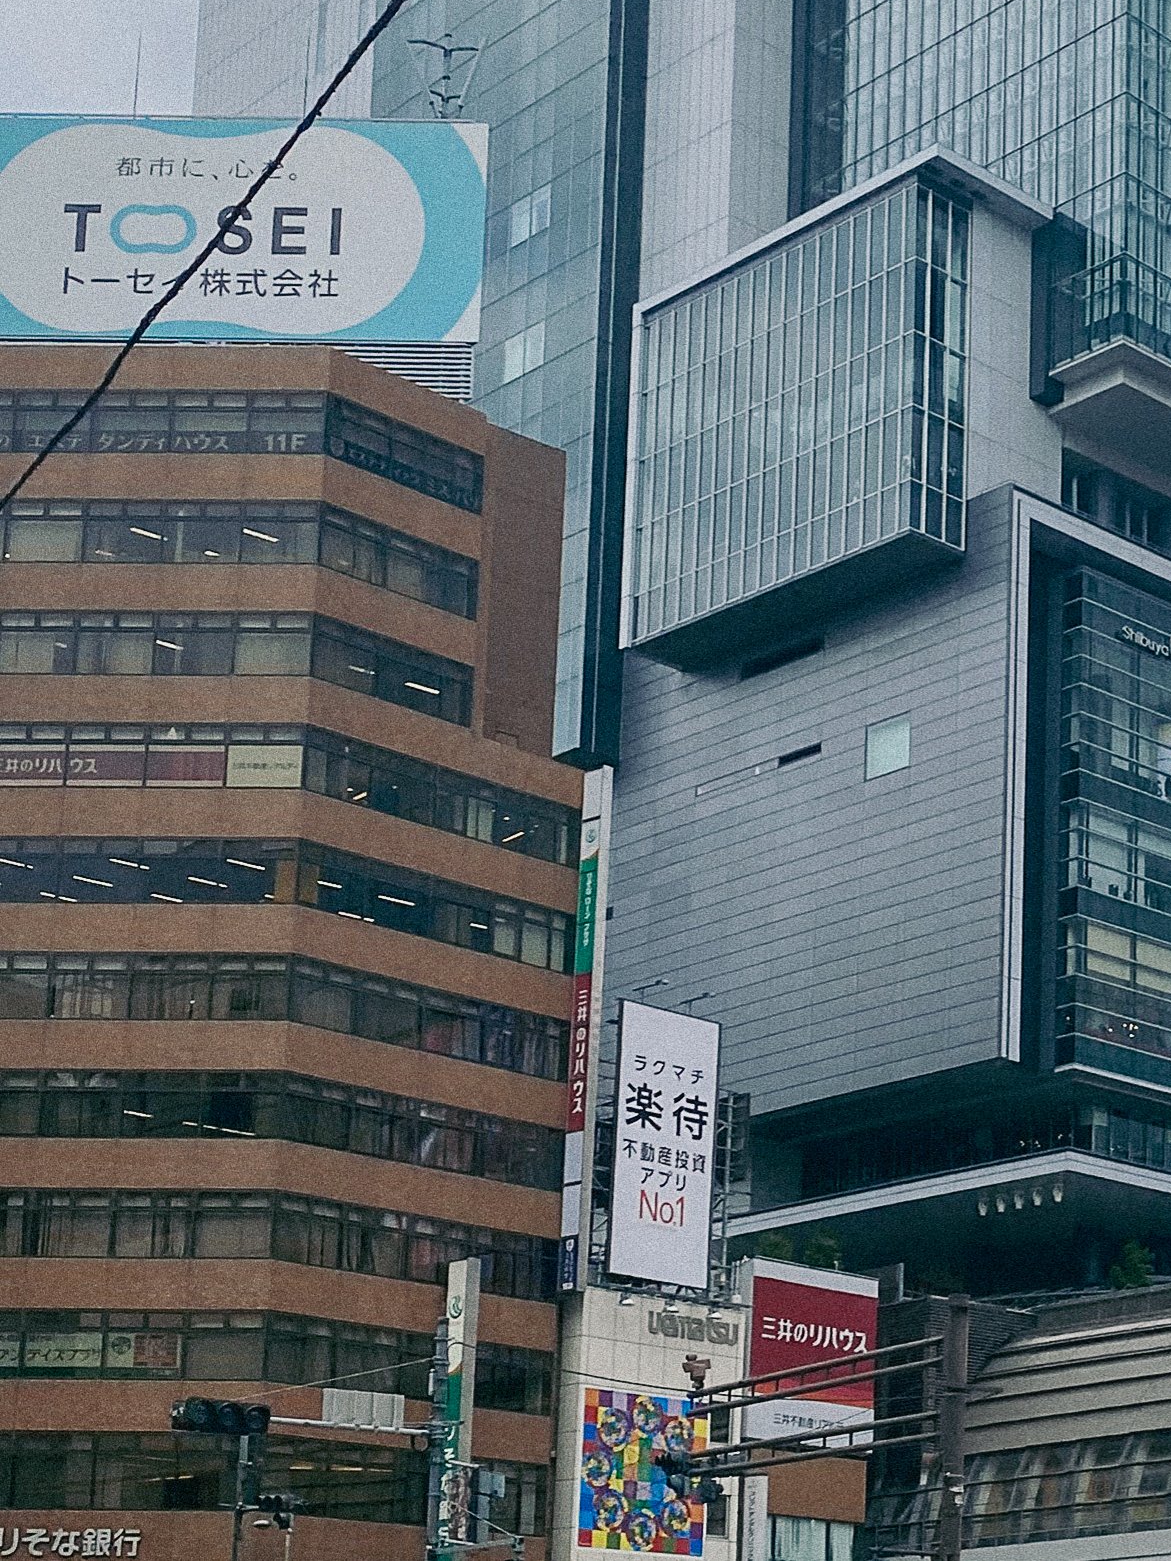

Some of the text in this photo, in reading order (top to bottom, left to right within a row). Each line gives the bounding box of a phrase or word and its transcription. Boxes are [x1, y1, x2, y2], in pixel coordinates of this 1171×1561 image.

[63, 203, 343, 256] TOSEI
[1121, 625, 1169, 656] Shibuya
[571, 989, 588, 1114] 三井のリハウス
[634, 1054, 704, 1085] ラクマチ
[625, 1082, 709, 1141] 楽待
[622, 1138, 706, 1174] 不動産投資
[641, 1167, 687, 1192] アプリ
[639, 1189, 685, 1227] No.1
[761, 1315, 868, 1353] 三井のリハウス
[0, 1527, 141, 1557] りそな銀行
